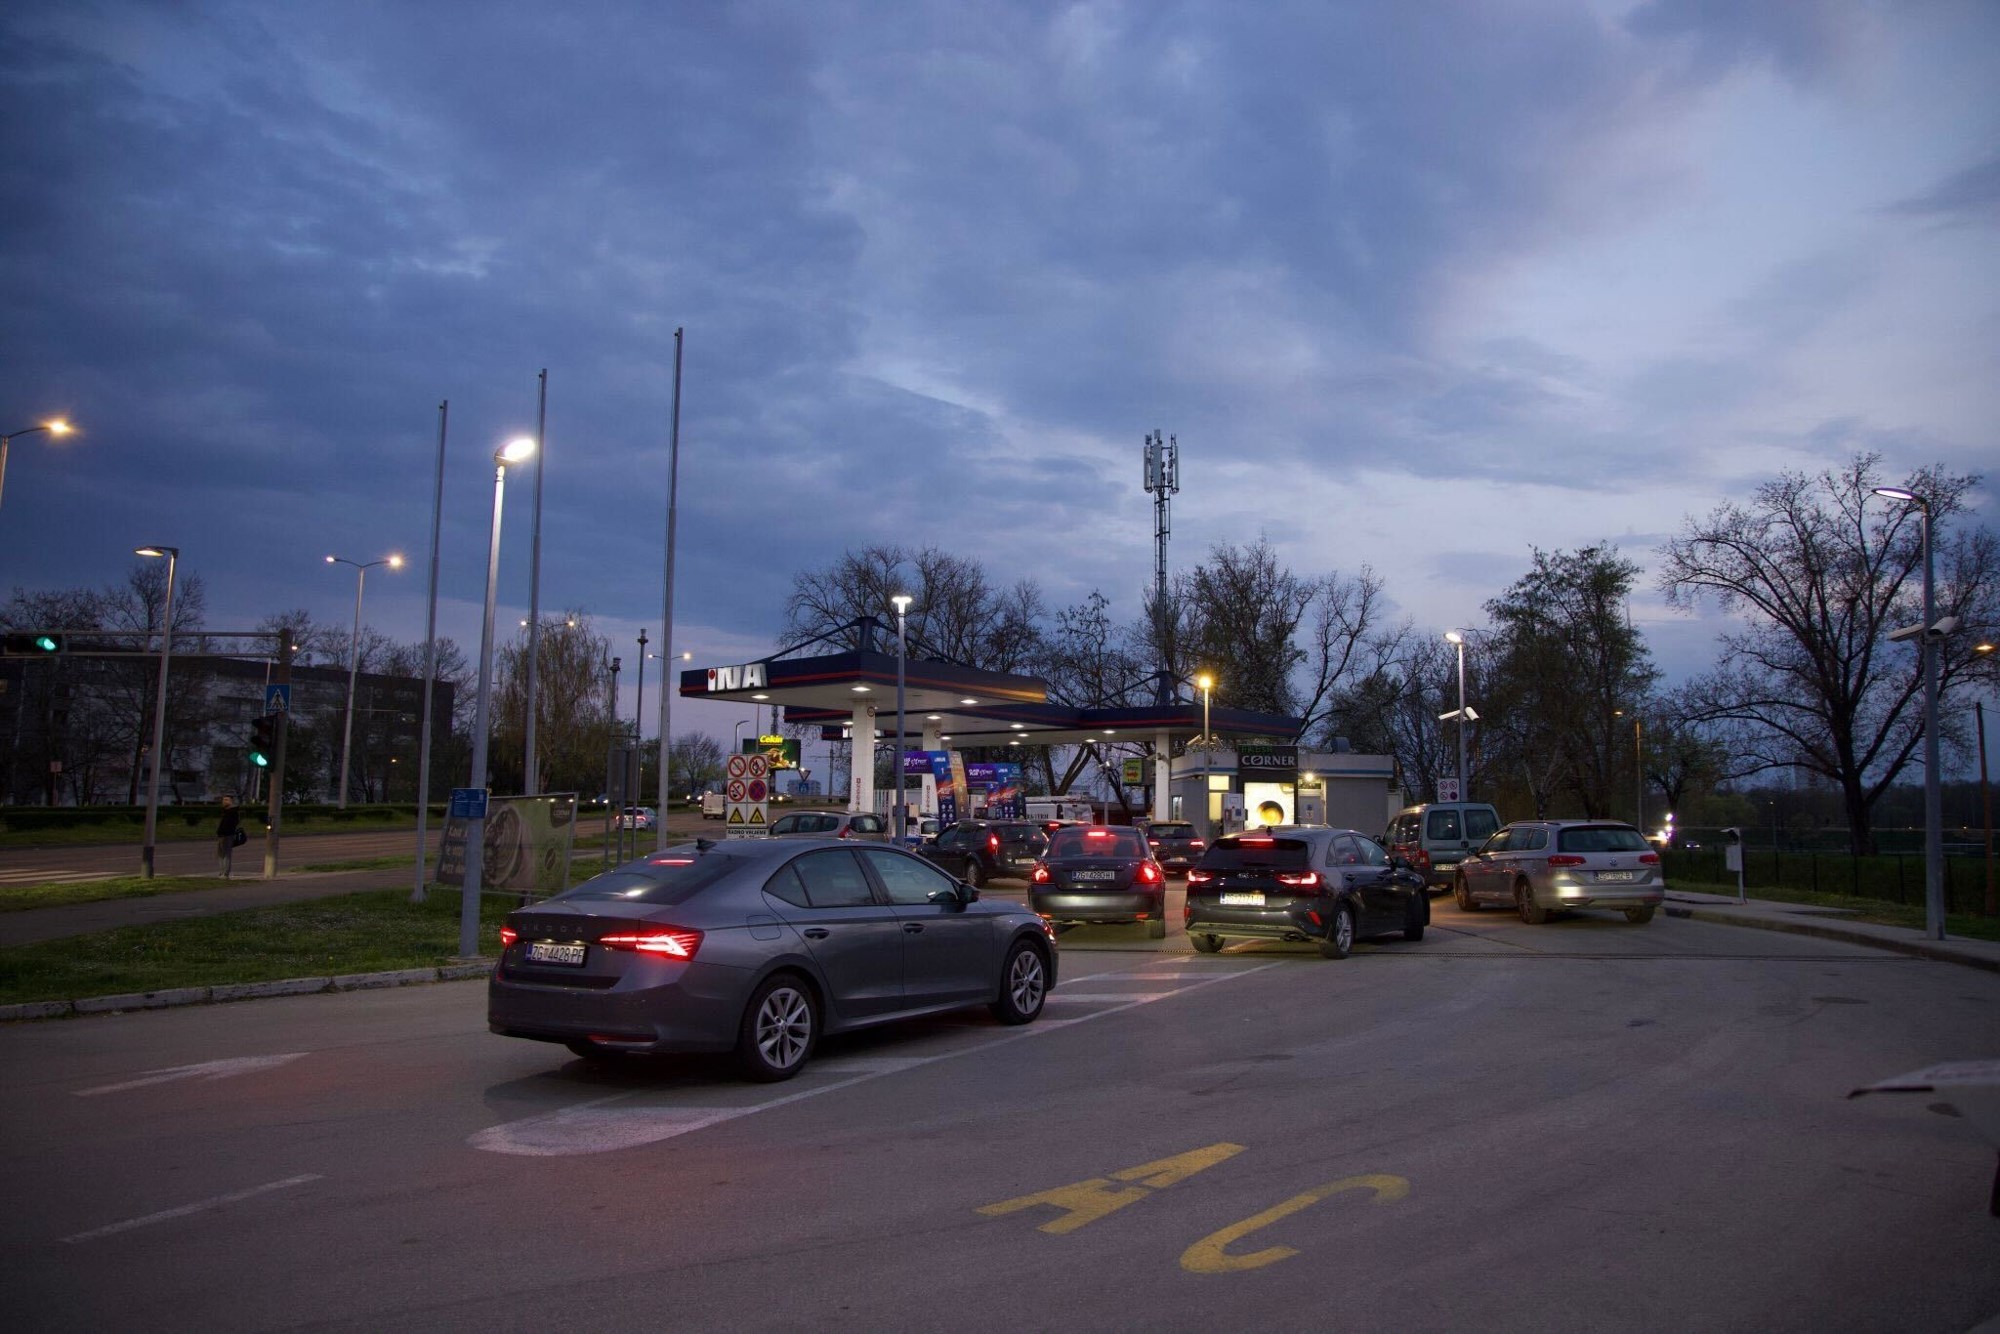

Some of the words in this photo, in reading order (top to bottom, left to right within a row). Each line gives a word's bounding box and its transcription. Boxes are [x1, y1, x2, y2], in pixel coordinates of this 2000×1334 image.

[707, 663, 768, 692] INA
[1241, 755, 1296, 766] CORNER
[531, 945, 544, 960] ZG
